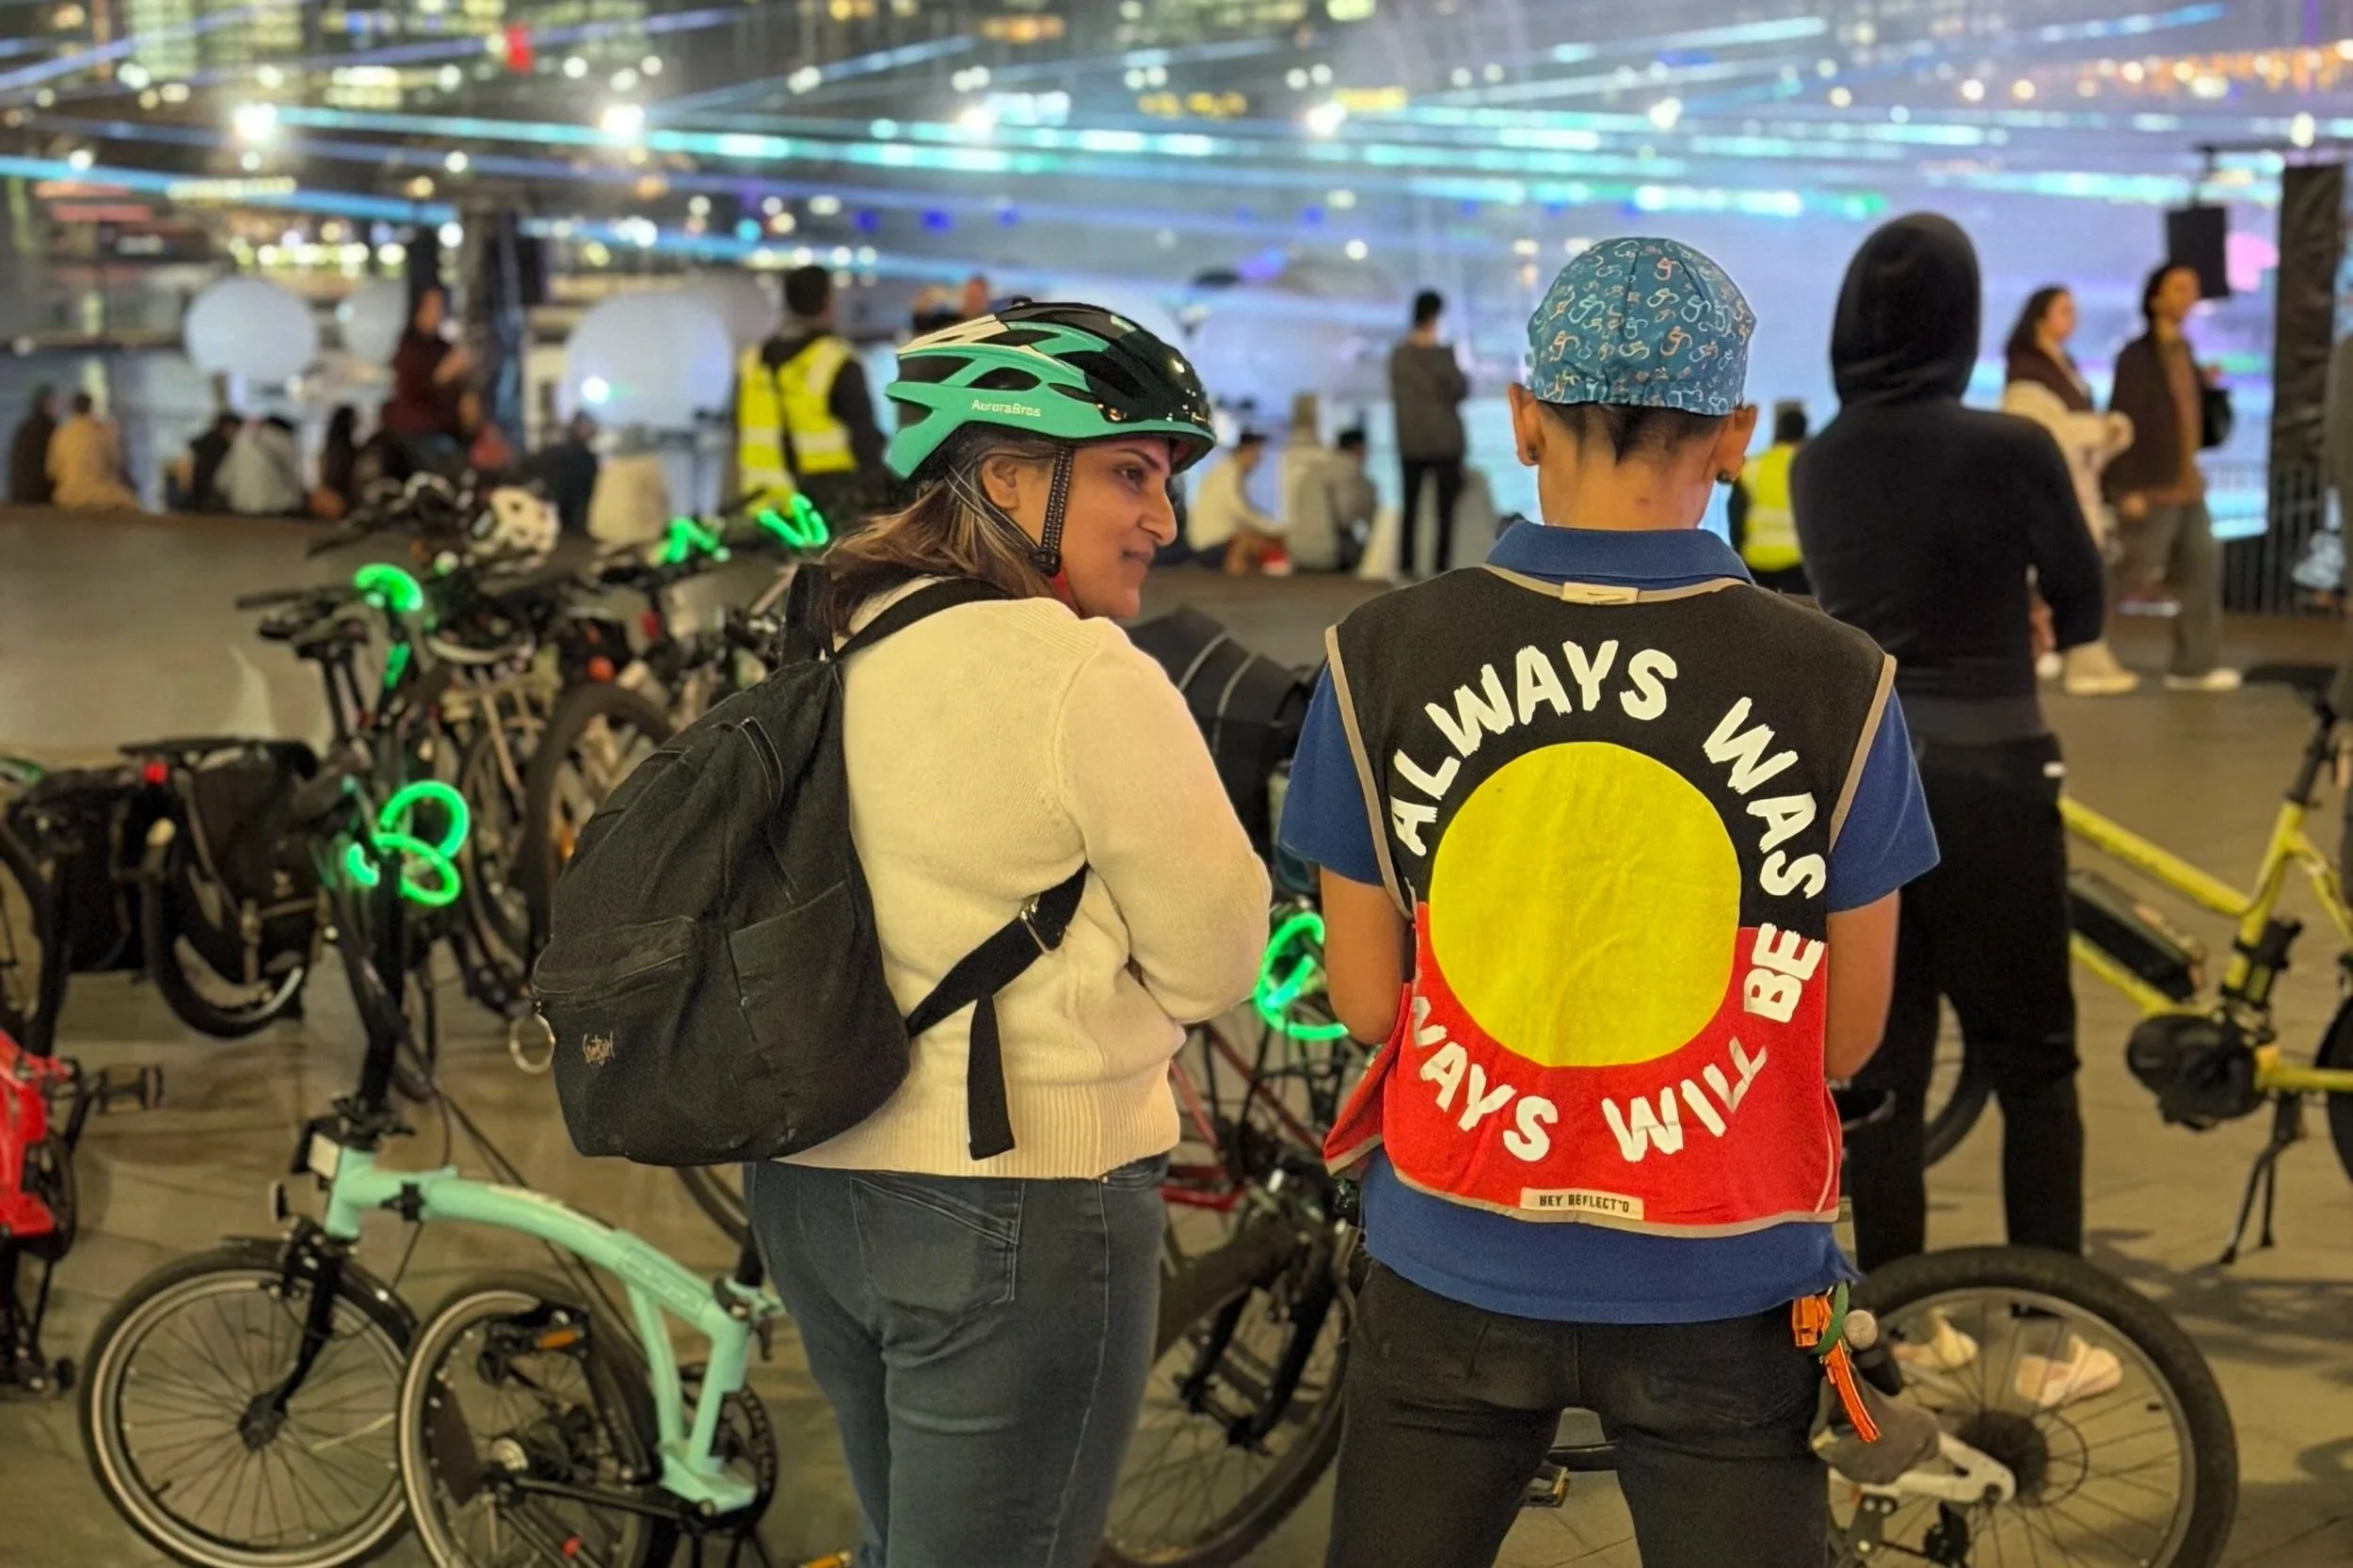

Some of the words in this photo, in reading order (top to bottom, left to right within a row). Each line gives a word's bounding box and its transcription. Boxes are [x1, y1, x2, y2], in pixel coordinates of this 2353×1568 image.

[971, 398, 1041, 418] AuroraBros
[1390, 640, 1678, 856] ALWAYS
[1702, 696, 1827, 900] WAS
[1601, 1036, 1769, 1162] WILL
[1743, 922, 1824, 1023] BE
[1539, 1194, 1562, 1207] HEY
